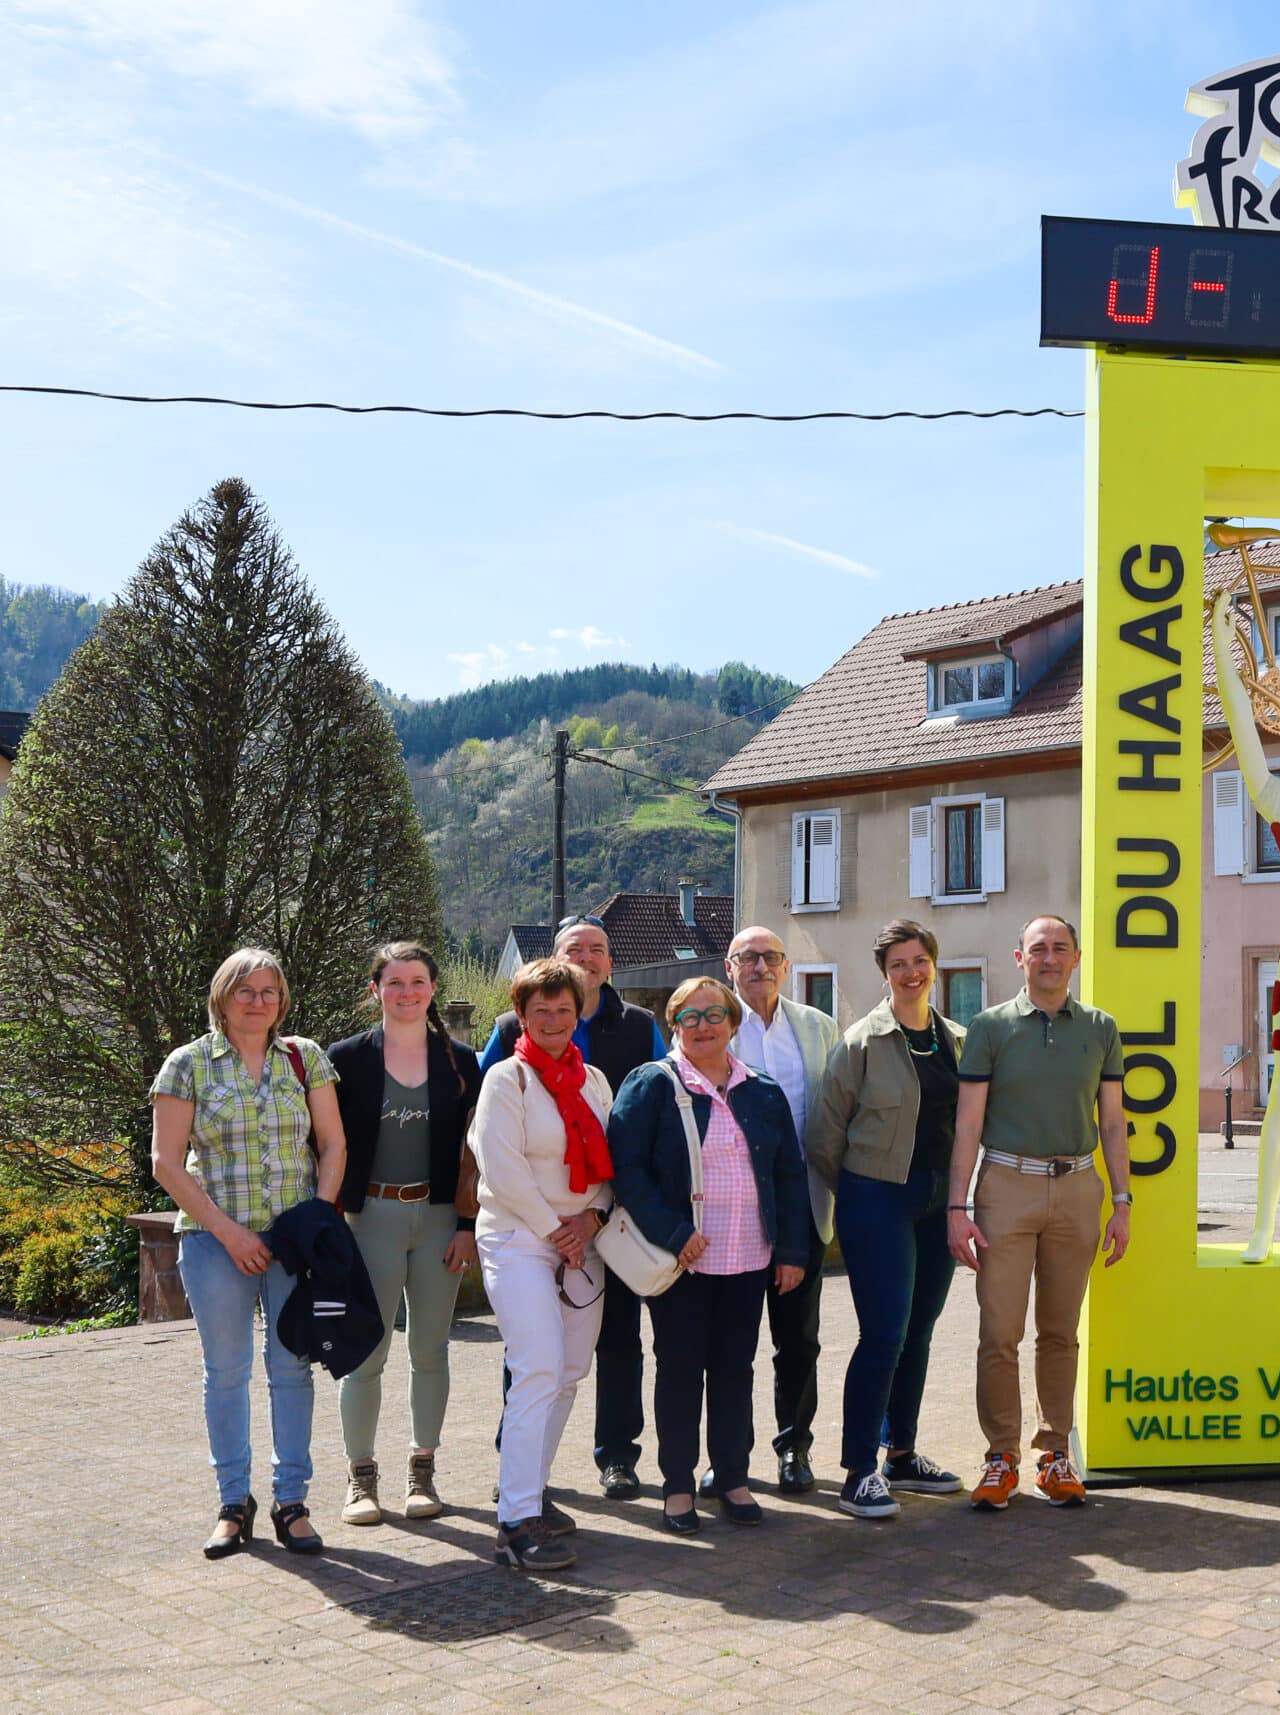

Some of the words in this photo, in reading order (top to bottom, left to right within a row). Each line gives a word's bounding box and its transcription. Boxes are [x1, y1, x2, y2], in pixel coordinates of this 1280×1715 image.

[1118, 543, 1185, 793] HAAG
[1116, 837, 1181, 949] DU
[1121, 1001, 1177, 1177] COL
[1105, 1368, 1239, 1403] Hautes
[1126, 1414, 1242, 1441] VALLEE
